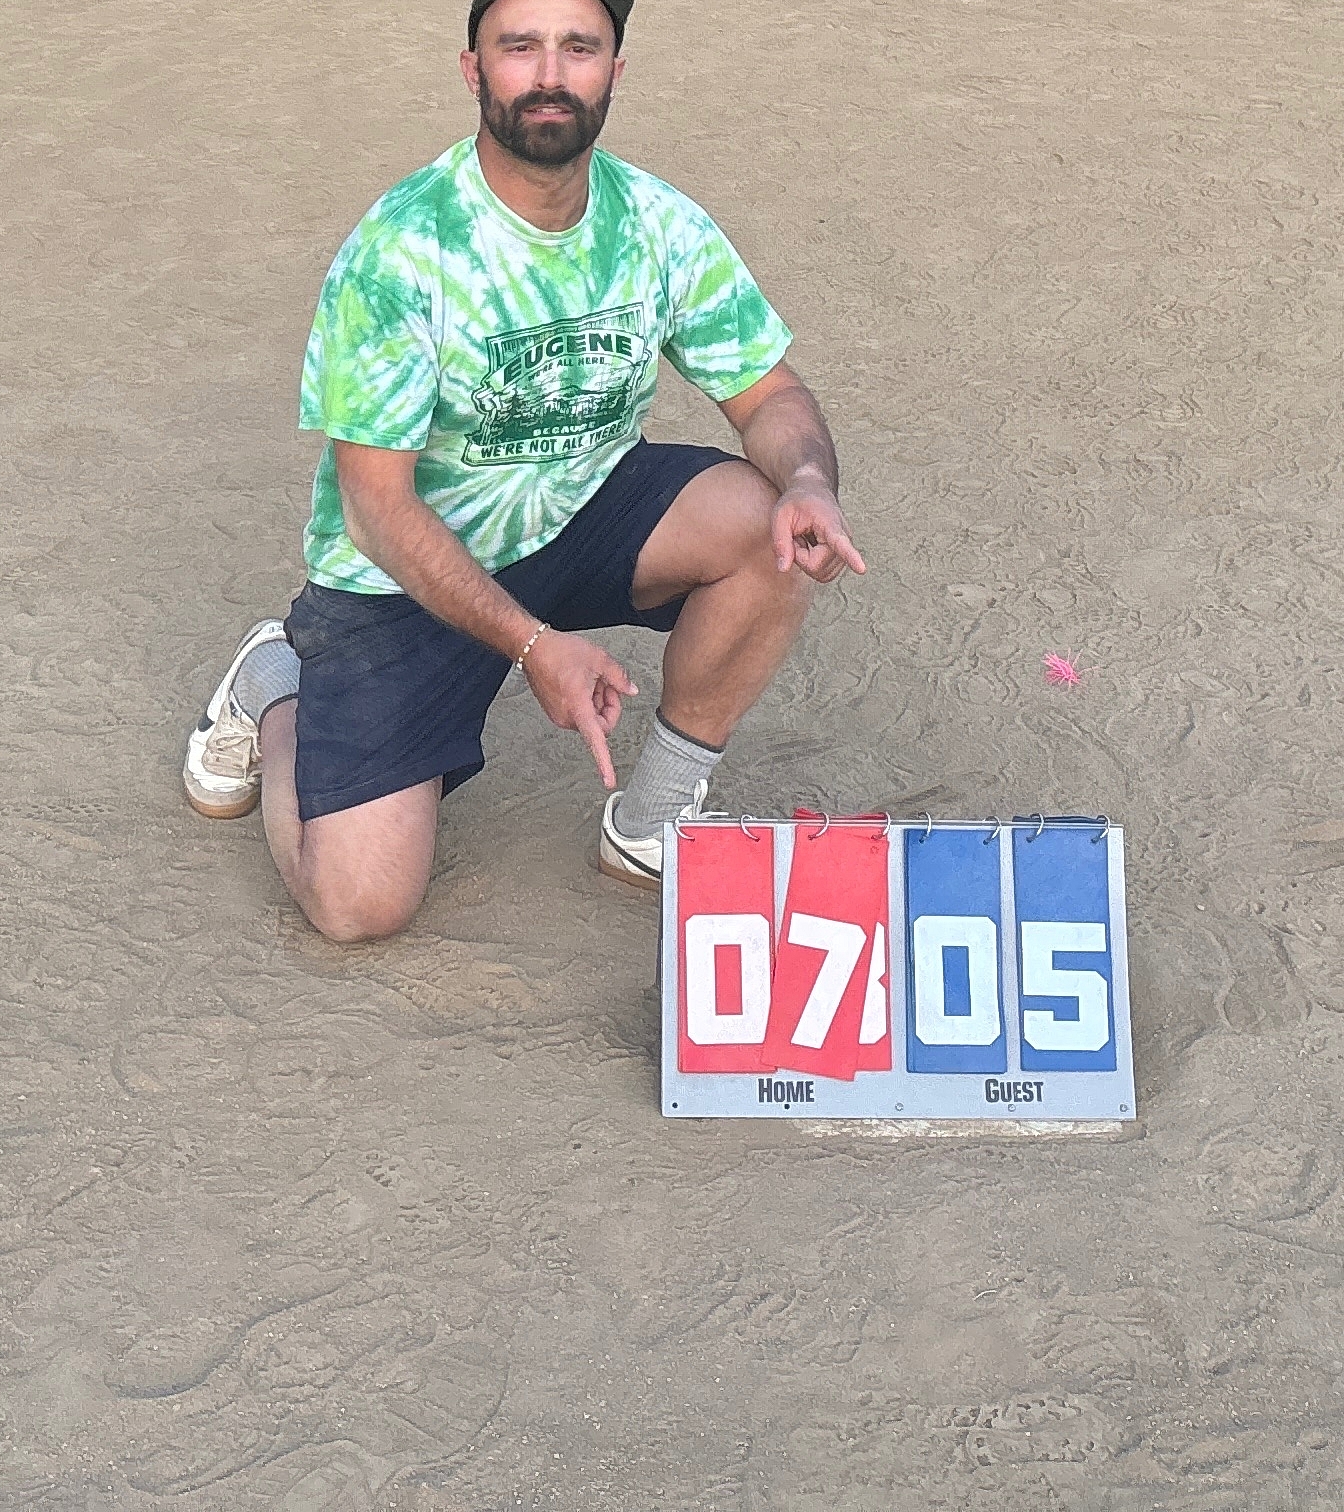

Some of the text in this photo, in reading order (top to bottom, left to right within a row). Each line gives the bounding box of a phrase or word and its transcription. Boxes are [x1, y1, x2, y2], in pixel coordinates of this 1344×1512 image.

[504, 333, 632, 386] EUGENE
[557, 358, 573, 367] ALL
[533, 421, 596, 437] BECAUSE
[481, 441, 524, 459] WE'RE
[529, 439, 557, 454] NOT
[562, 437, 584, 451] ALL
[758, 1078, 814, 1103] HOME
[985, 1079, 1044, 1103] GUEST
